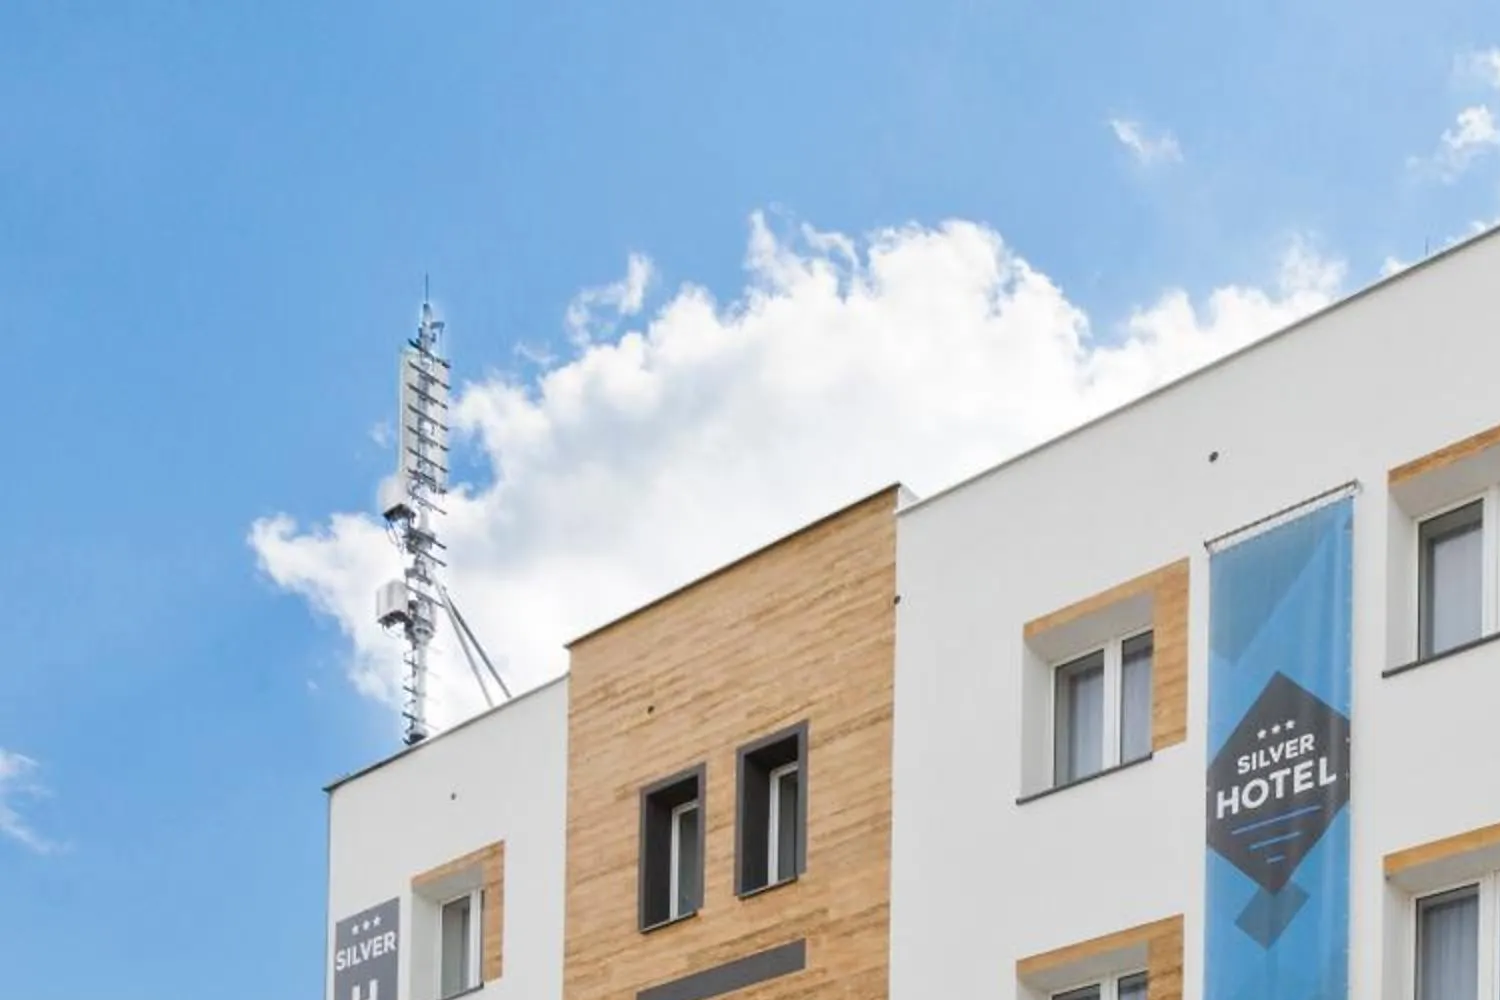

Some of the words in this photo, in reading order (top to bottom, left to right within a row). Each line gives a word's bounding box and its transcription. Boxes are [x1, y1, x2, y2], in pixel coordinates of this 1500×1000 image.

[1237, 733, 1315, 775] SILVER
[1216, 757, 1337, 819] HOTEL
[335, 931, 397, 971] SILVER
